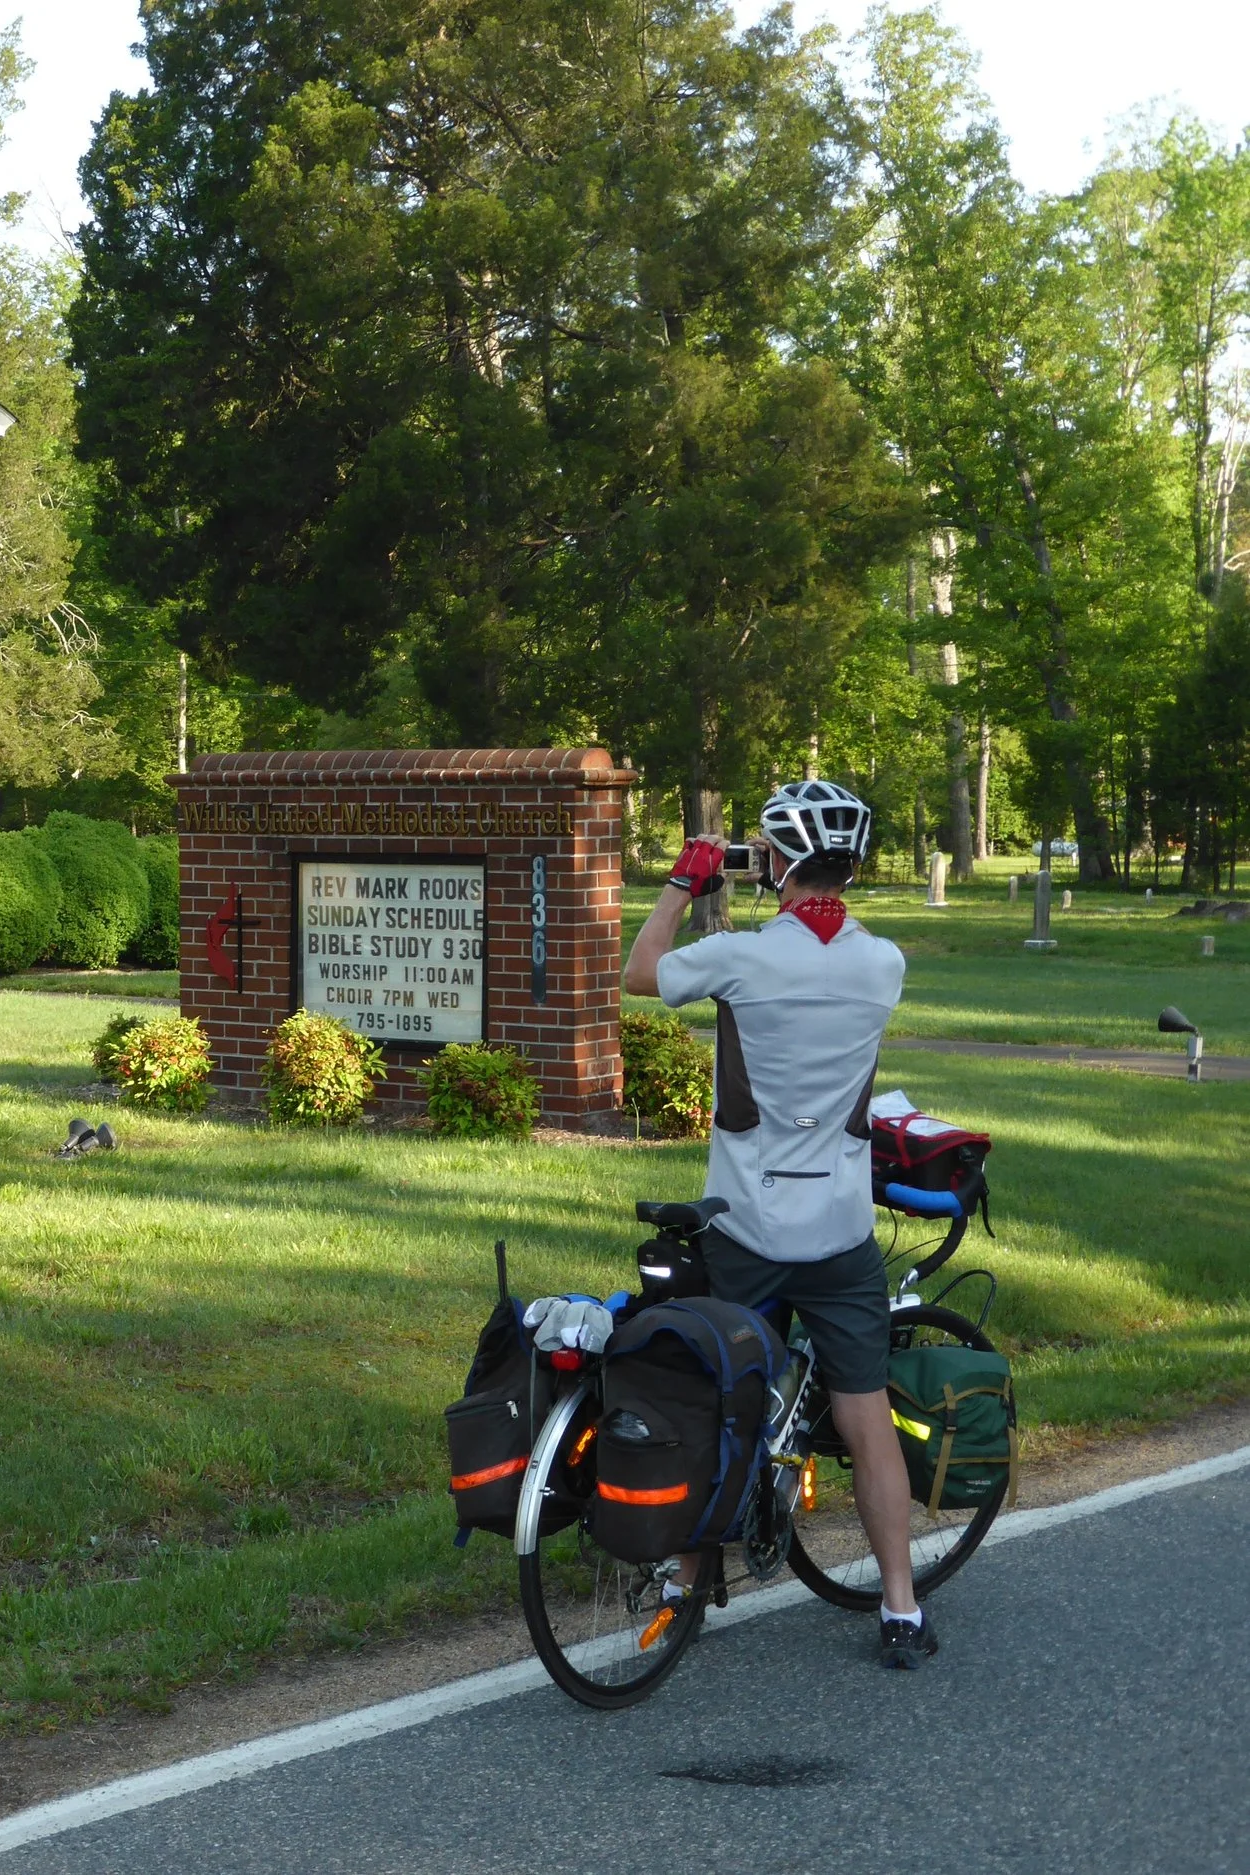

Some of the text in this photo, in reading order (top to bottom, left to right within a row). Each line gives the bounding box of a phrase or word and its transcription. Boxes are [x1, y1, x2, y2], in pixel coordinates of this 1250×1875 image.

[180, 801, 573, 834] Willis United Methodist Church
[311, 876, 482, 900] REV MARK ROOKS
[307, 904, 483, 931] SUNDAY SCHEDULE
[308, 933, 362, 956] BIBLE
[370, 935, 432, 959] STUDY
[319, 962, 388, 982] WORSHIP
[326, 986, 460, 1009] CHOIR 7PM WED
[357, 1012, 433, 1032] 795-1895
